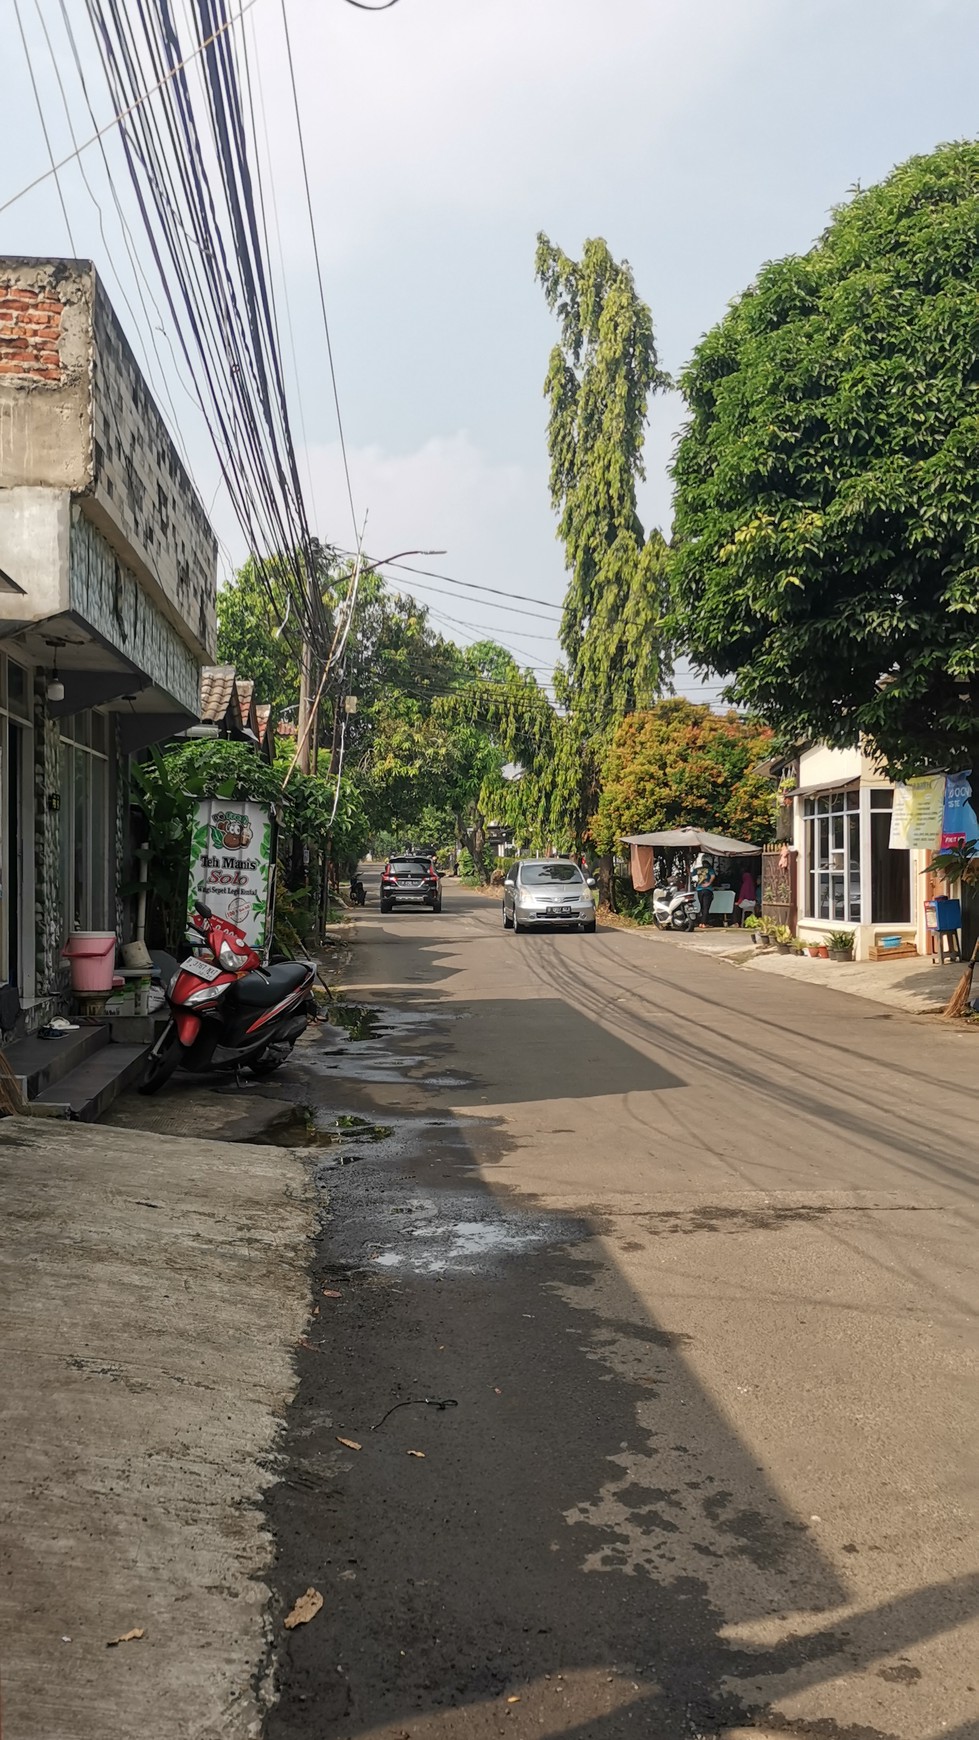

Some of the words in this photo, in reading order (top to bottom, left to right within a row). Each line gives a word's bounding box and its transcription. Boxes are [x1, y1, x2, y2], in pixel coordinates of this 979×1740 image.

[200, 855, 219, 868] Teh
[222, 856, 257, 871] Manis
[208, 870, 249, 886] Solo
